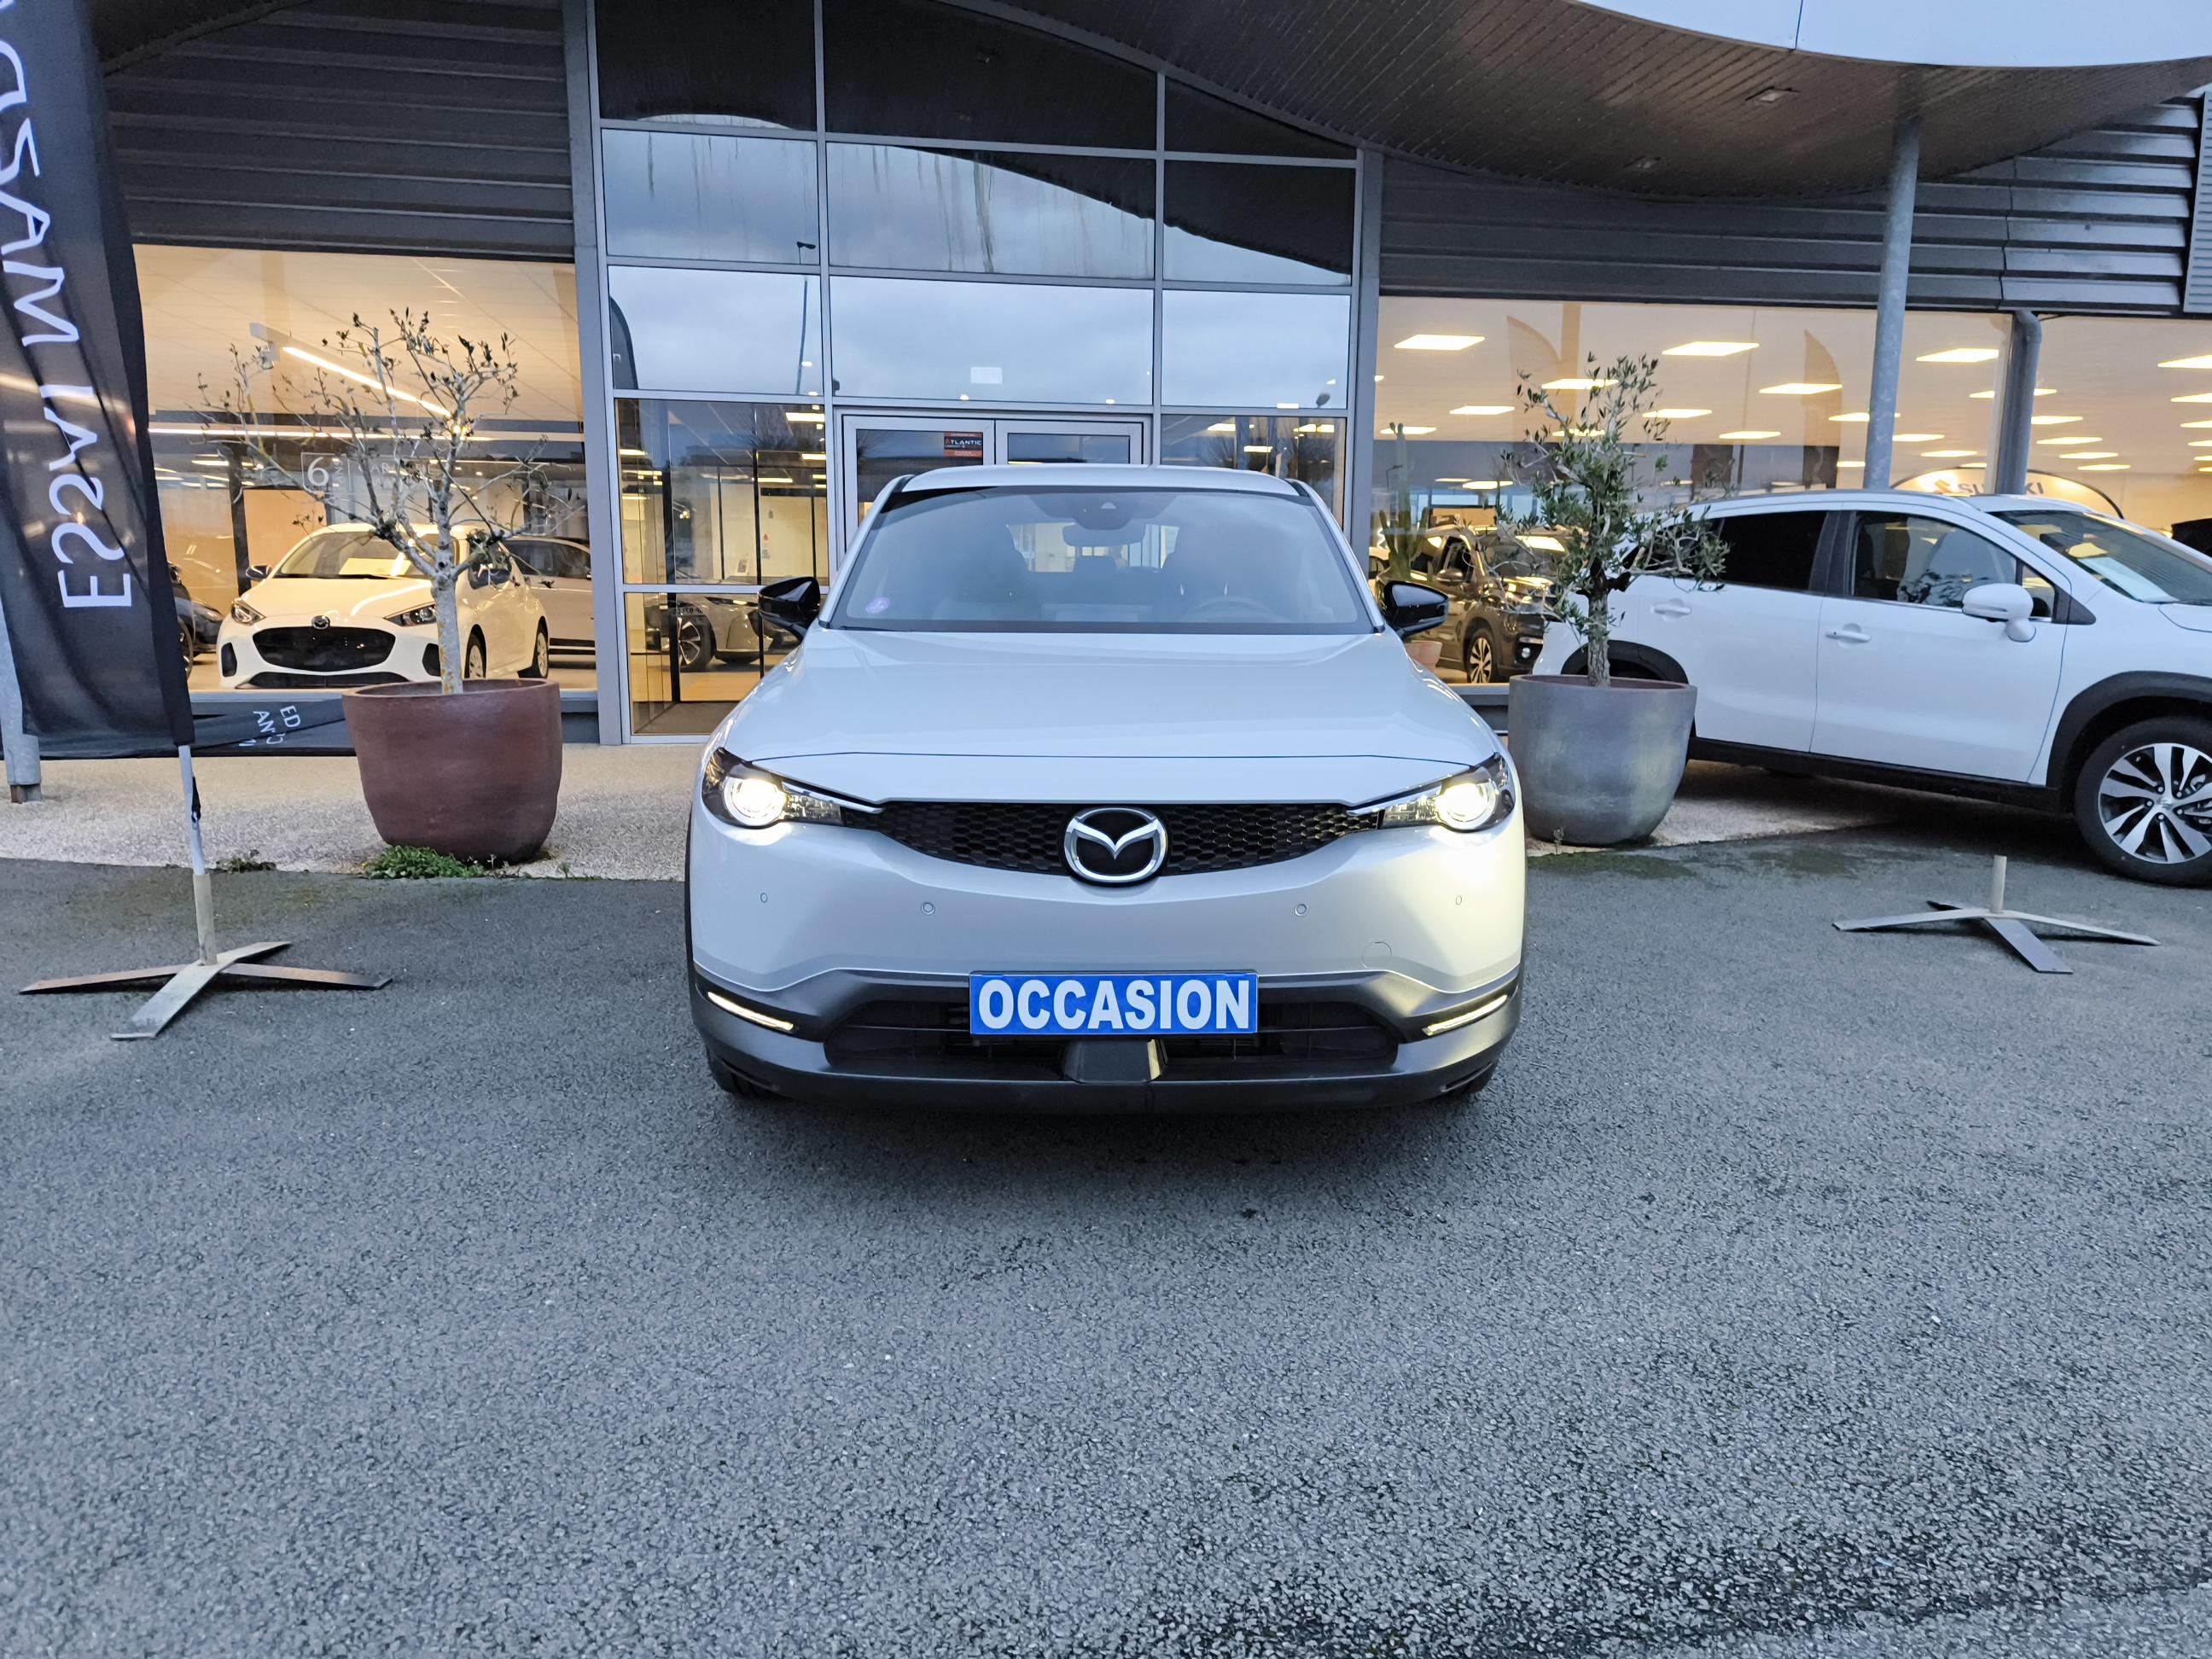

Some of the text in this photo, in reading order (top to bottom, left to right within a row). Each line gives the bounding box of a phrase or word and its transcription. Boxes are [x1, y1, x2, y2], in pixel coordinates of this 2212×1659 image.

[307, 457, 329, 486] 6
[1957, 481, 2045, 495] SUKI
[978, 979, 1250, 1030] OCCASION
